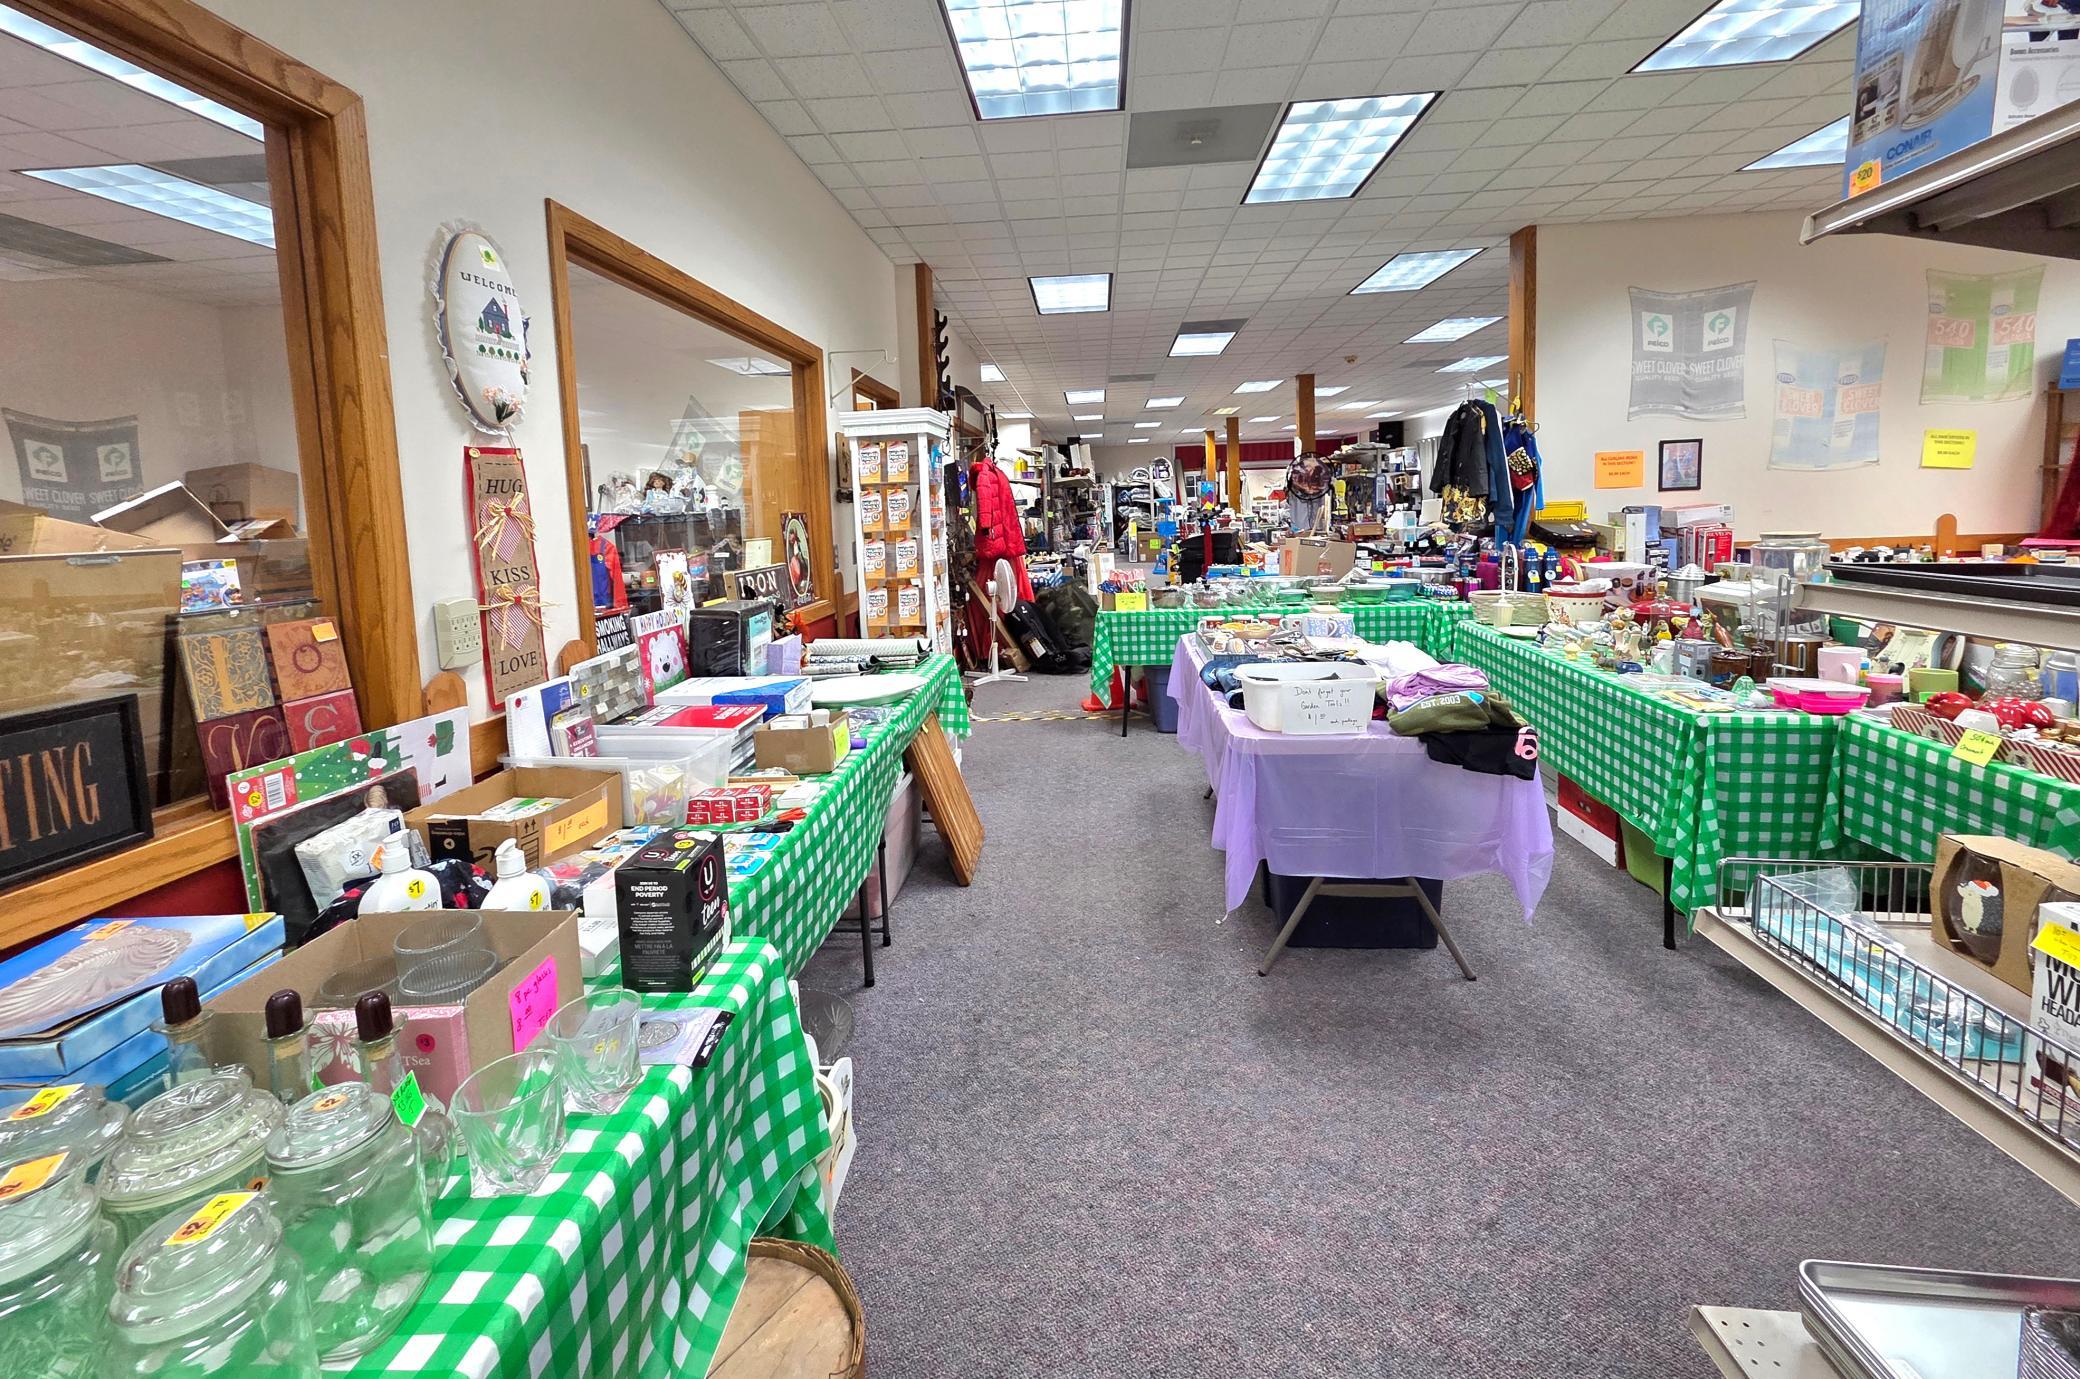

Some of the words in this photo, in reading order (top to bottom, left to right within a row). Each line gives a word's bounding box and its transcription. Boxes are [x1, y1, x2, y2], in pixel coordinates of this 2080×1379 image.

[1886, 128, 1934, 161] CONAIR
[1857, 166, 1874, 182] $20
[1689, 359, 1716, 377] SWEET
[485, 478, 523, 495] HUG
[490, 565, 531, 586] KISS
[595, 614, 627, 639] SMOKING
[499, 650, 538, 677] LOVE
[408, 880, 421, 895] $7
[529, 892, 540, 907] $7
